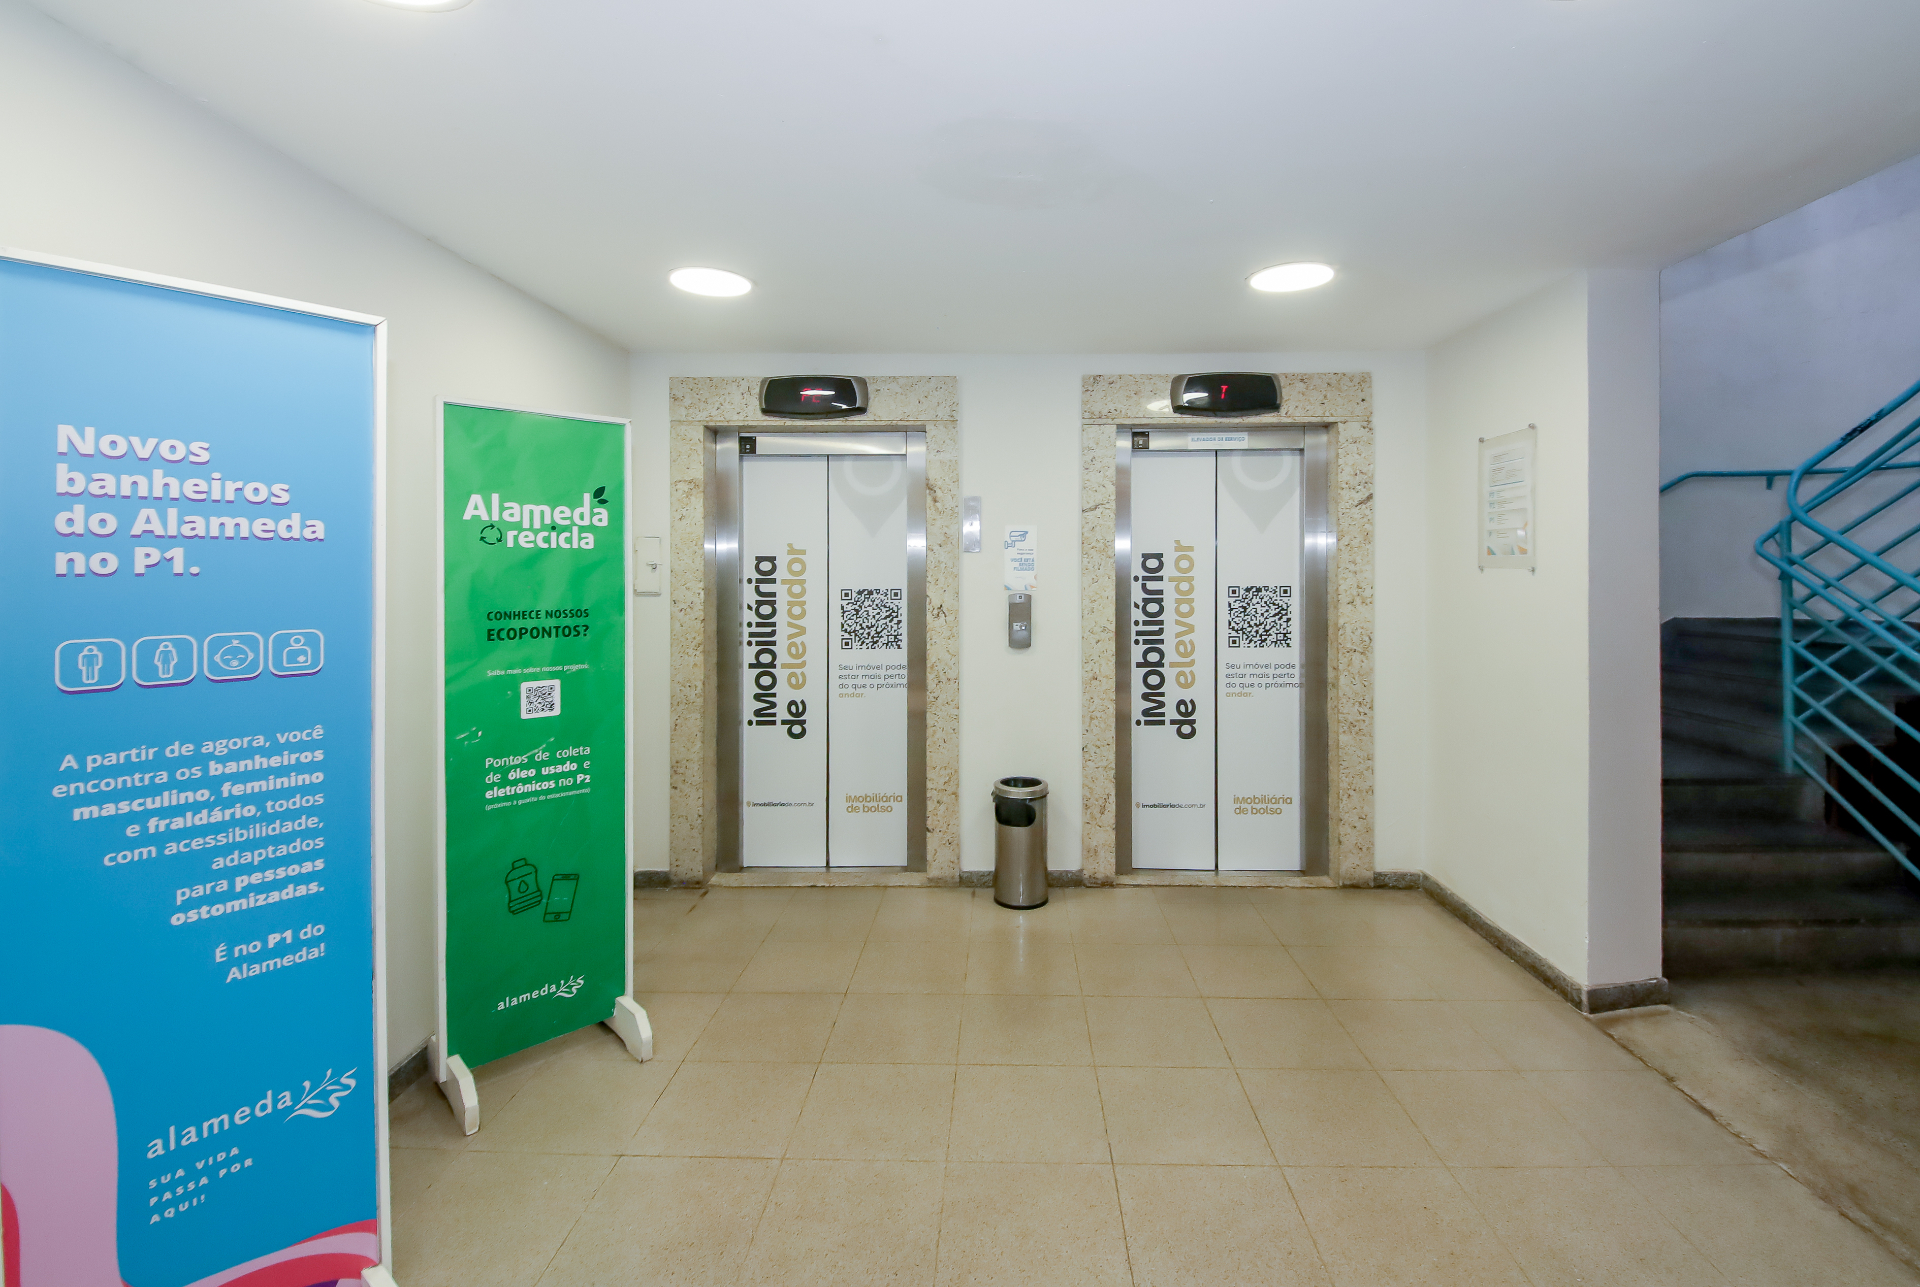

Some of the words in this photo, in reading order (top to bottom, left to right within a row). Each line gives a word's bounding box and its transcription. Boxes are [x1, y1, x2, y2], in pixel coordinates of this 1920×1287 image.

[1220, 386, 1228, 399] T
[56, 424, 210, 464] Novos
[56, 463, 290, 506] banheiros
[54, 504, 118, 537] do
[130, 508, 325, 542] Alameda
[462, 493, 608, 528] Alameda
[506, 526, 594, 549] recicla
[54, 550, 119, 578] no
[134, 547, 200, 577] P1.
[486, 609, 542, 621] CONHECE
[545, 608, 589, 620] NOSSOS
[486, 624, 589, 642] ECOPONTOS?
[780, 543, 806, 690] elevador
[1168, 540, 1196, 690] elevador
[884, 673, 906, 681] perto
[886, 664, 908, 672] pode
[1243, 662, 1272, 670] imóvel
[1274, 662, 1296, 670] pode
[1239, 682, 1255, 690] que
[780, 699, 806, 740] de
[1170, 698, 1196, 740] de
[59, 754, 78, 772] A
[86, 745, 158, 772] partir
[165, 741, 194, 758] de
[201, 735, 270, 756] agora,
[276, 724, 324, 744] você
[485, 755, 528, 768] Pontos
[534, 750, 550, 761] de
[556, 746, 590, 758] coleta
[52, 771, 168, 798] encontra
[176, 766, 202, 780] os
[208, 750, 324, 776] banheiros
[485, 772, 501, 784] de
[508, 768, 536, 780] óleo
[542, 761, 578, 775] usado
[584, 760, 590, 768] e
[485, 780, 555, 798] eletrônicos
[559, 777, 574, 787] no
[576, 774, 591, 784] P2
[73, 789, 215, 821] masculino,
[221, 772, 324, 798] feminino
[126, 824, 140, 837] e
[147, 803, 261, 834] fraldário,
[266, 794, 324, 813] todos
[846, 804, 860, 813] de
[862, 804, 893, 813] bolso
[1234, 806, 1248, 815] de
[1250, 805, 1282, 815] bolso
[103, 845, 157, 866] com
[164, 815, 324, 856] acessibilidade,
[212, 837, 324, 870] adaptados
[176, 879, 228, 905] para
[235, 858, 324, 892] pessoas
[170, 881, 324, 926] ostomizadas.
[215, 942, 227, 962] É
[234, 940, 262, 958] no
[268, 929, 292, 948] P1
[299, 924, 324, 940] do
[226, 942, 326, 983] Alameda!
[497, 984, 556, 1010] alameda
[146, 1090, 293, 1159] alameda
[149, 1168, 185, 1189] SUA
[196, 1147, 239, 1170] VIDA
[149, 1176, 208, 1207] PASSA
[219, 1158, 253, 1178] POR
[150, 1194, 205, 1225] AQUI!
